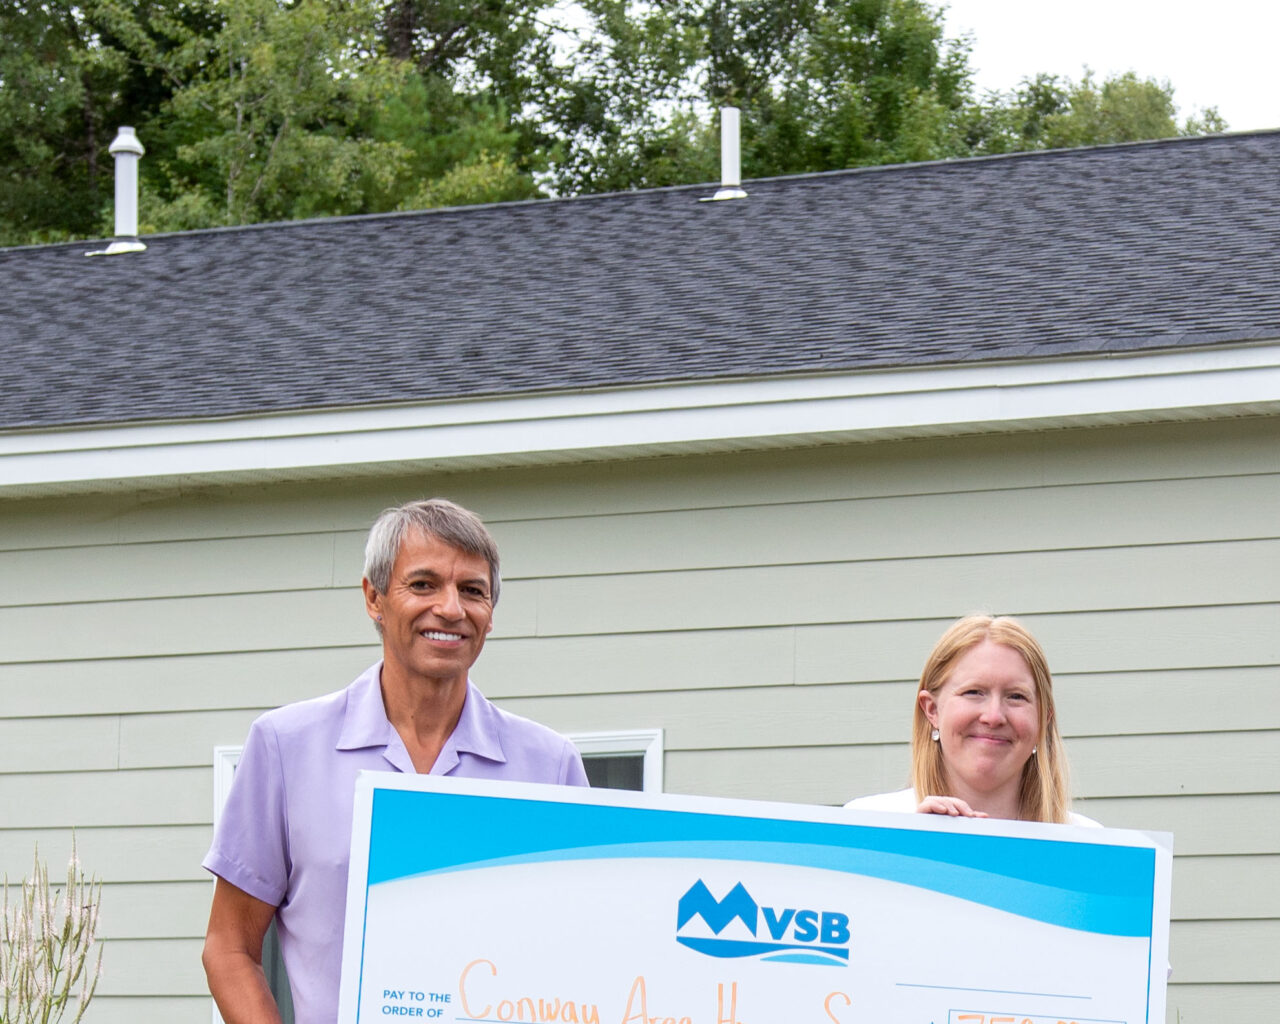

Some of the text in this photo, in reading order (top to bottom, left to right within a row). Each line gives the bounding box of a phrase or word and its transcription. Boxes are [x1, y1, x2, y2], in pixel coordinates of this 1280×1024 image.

[383, 989, 452, 1003] PAY TO THE
[382, 1005, 444, 1018] ORDER OF
